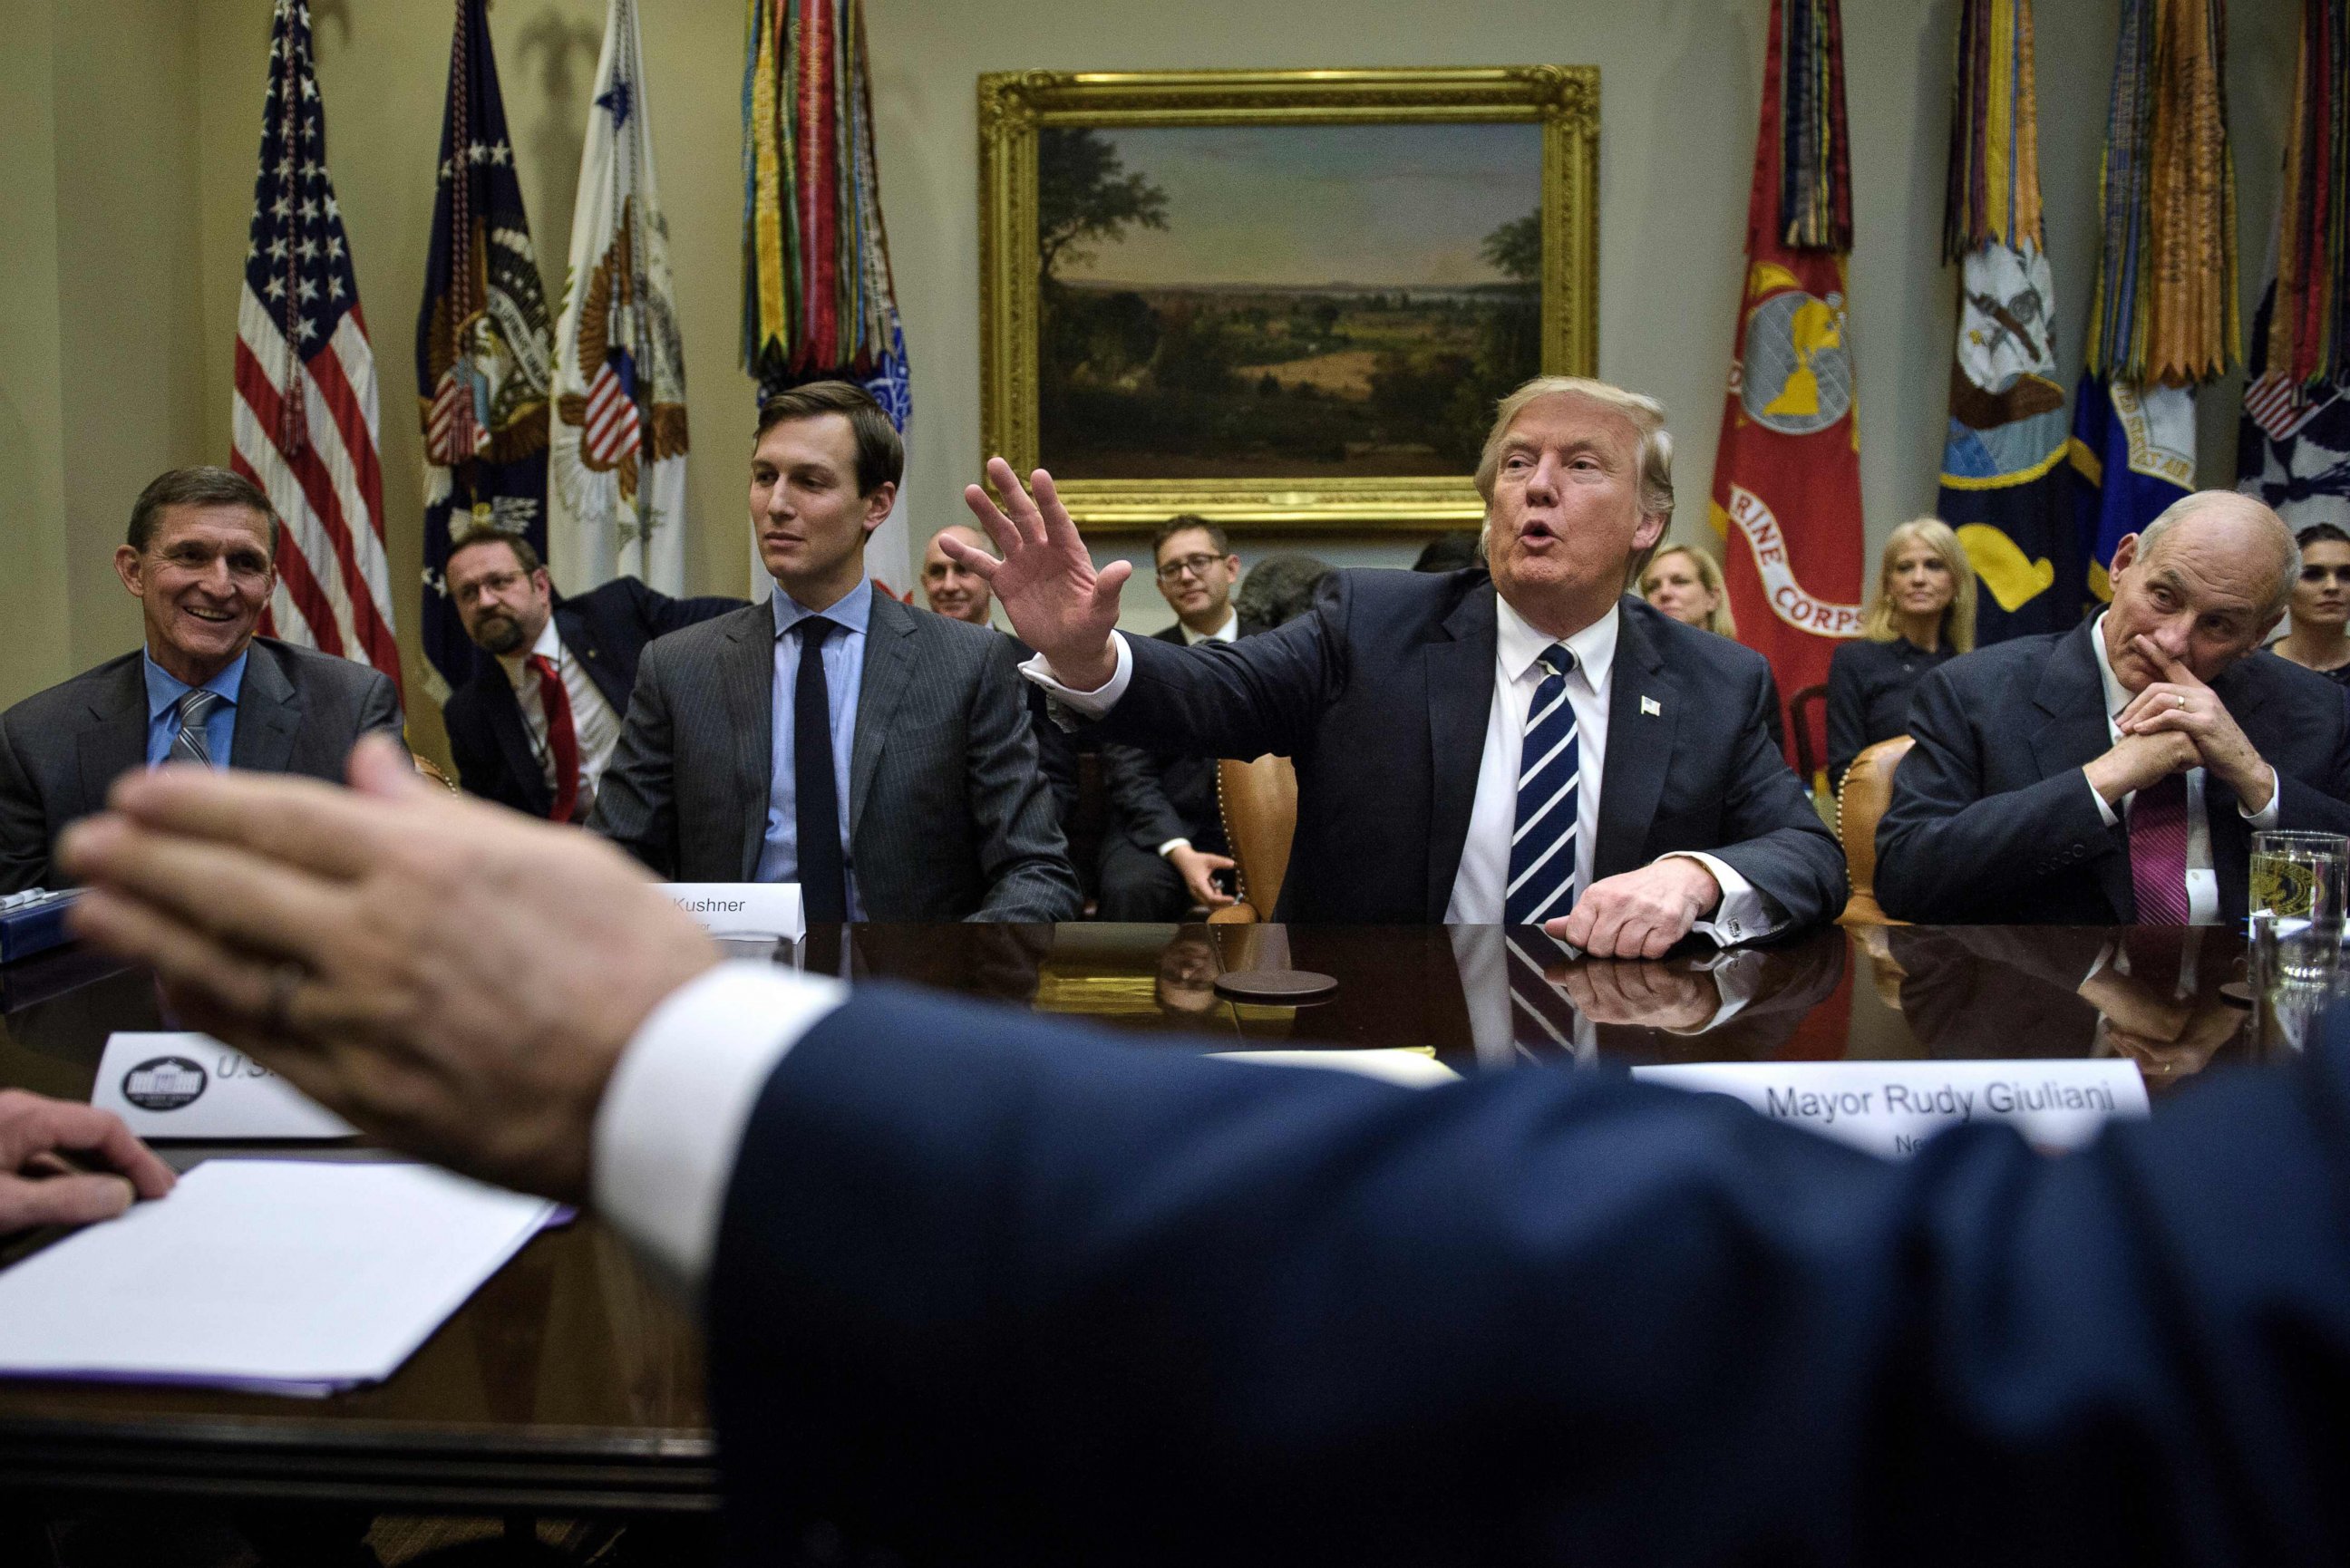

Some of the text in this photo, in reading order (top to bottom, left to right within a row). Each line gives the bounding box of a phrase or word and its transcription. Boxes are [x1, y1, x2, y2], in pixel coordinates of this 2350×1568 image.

[673, 896, 746, 913] Kushner
[1765, 1080, 2117, 1123] Mayor Rudy Giuliani
